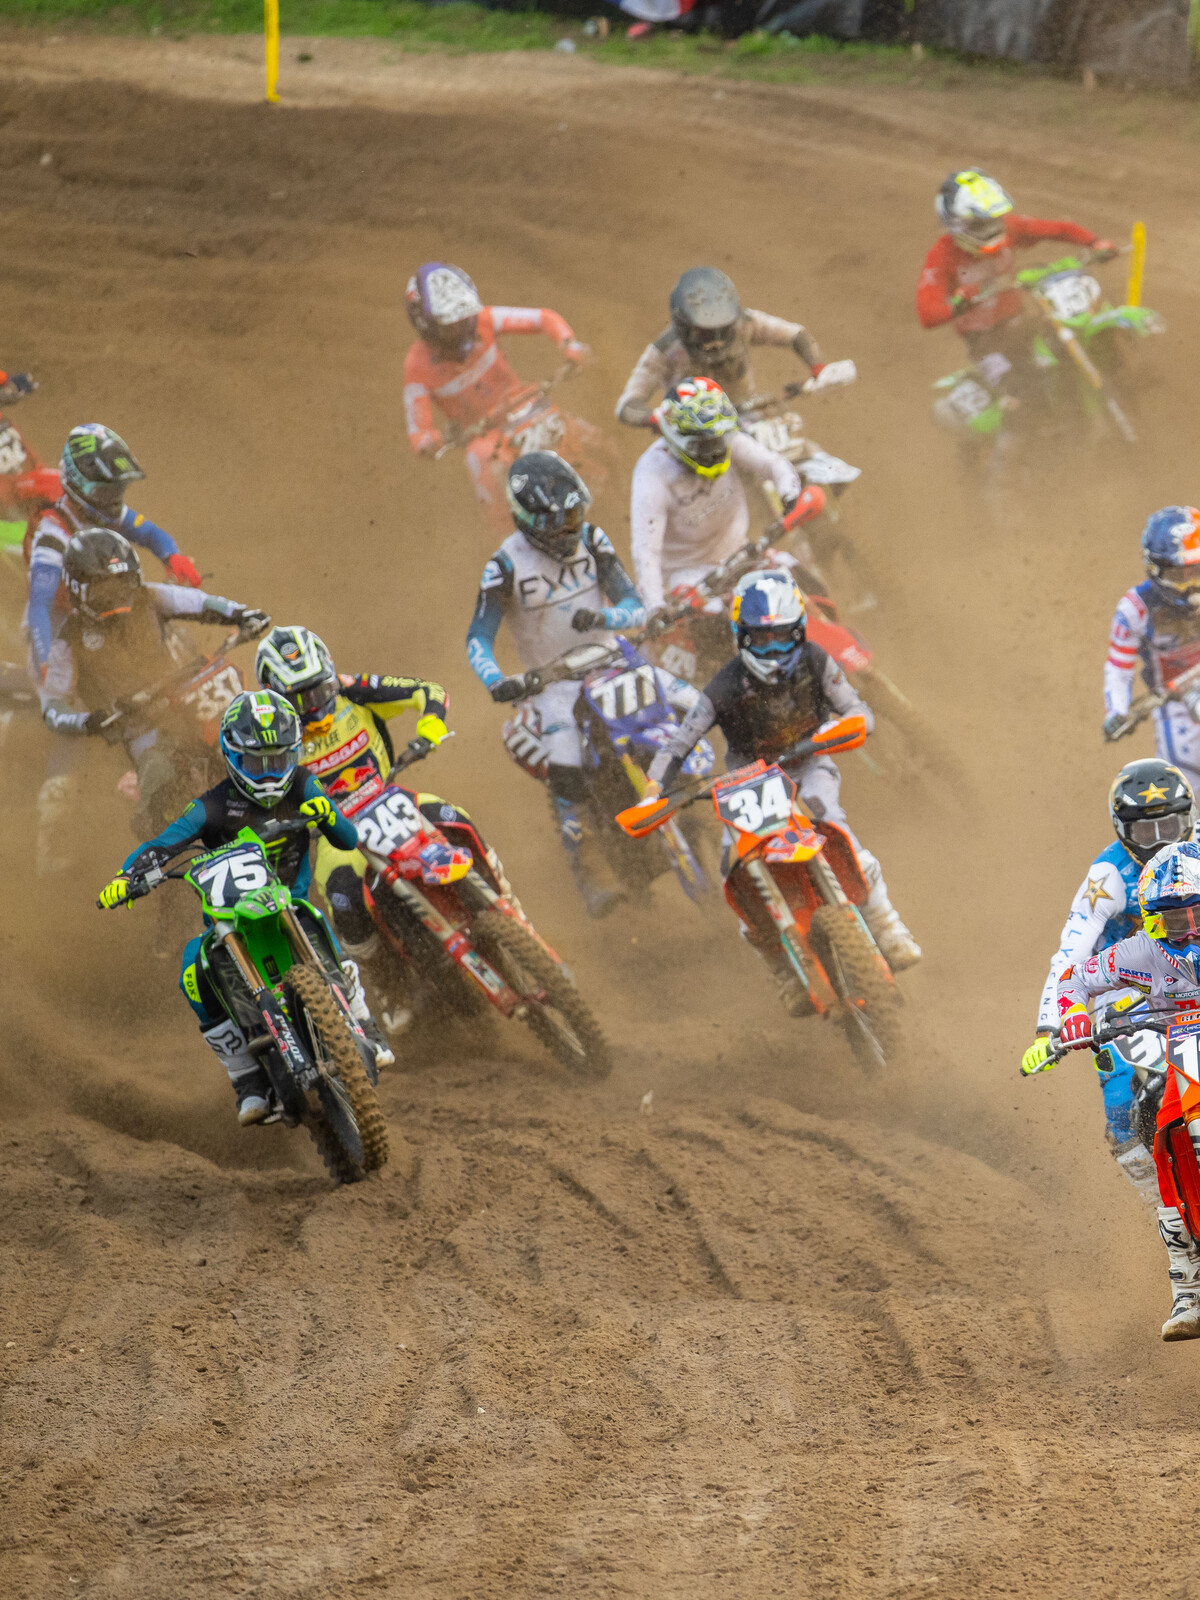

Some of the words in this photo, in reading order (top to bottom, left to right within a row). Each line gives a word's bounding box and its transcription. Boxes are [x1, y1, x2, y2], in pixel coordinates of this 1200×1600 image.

[518, 556, 597, 605] FXR
[308, 729, 368, 774] GASGAS
[357, 791, 424, 856] 243
[728, 775, 793, 832] 34
[198, 850, 268, 907] 75
[184, 972, 196, 997] FOX
[1119, 967, 1152, 979] PARTS
